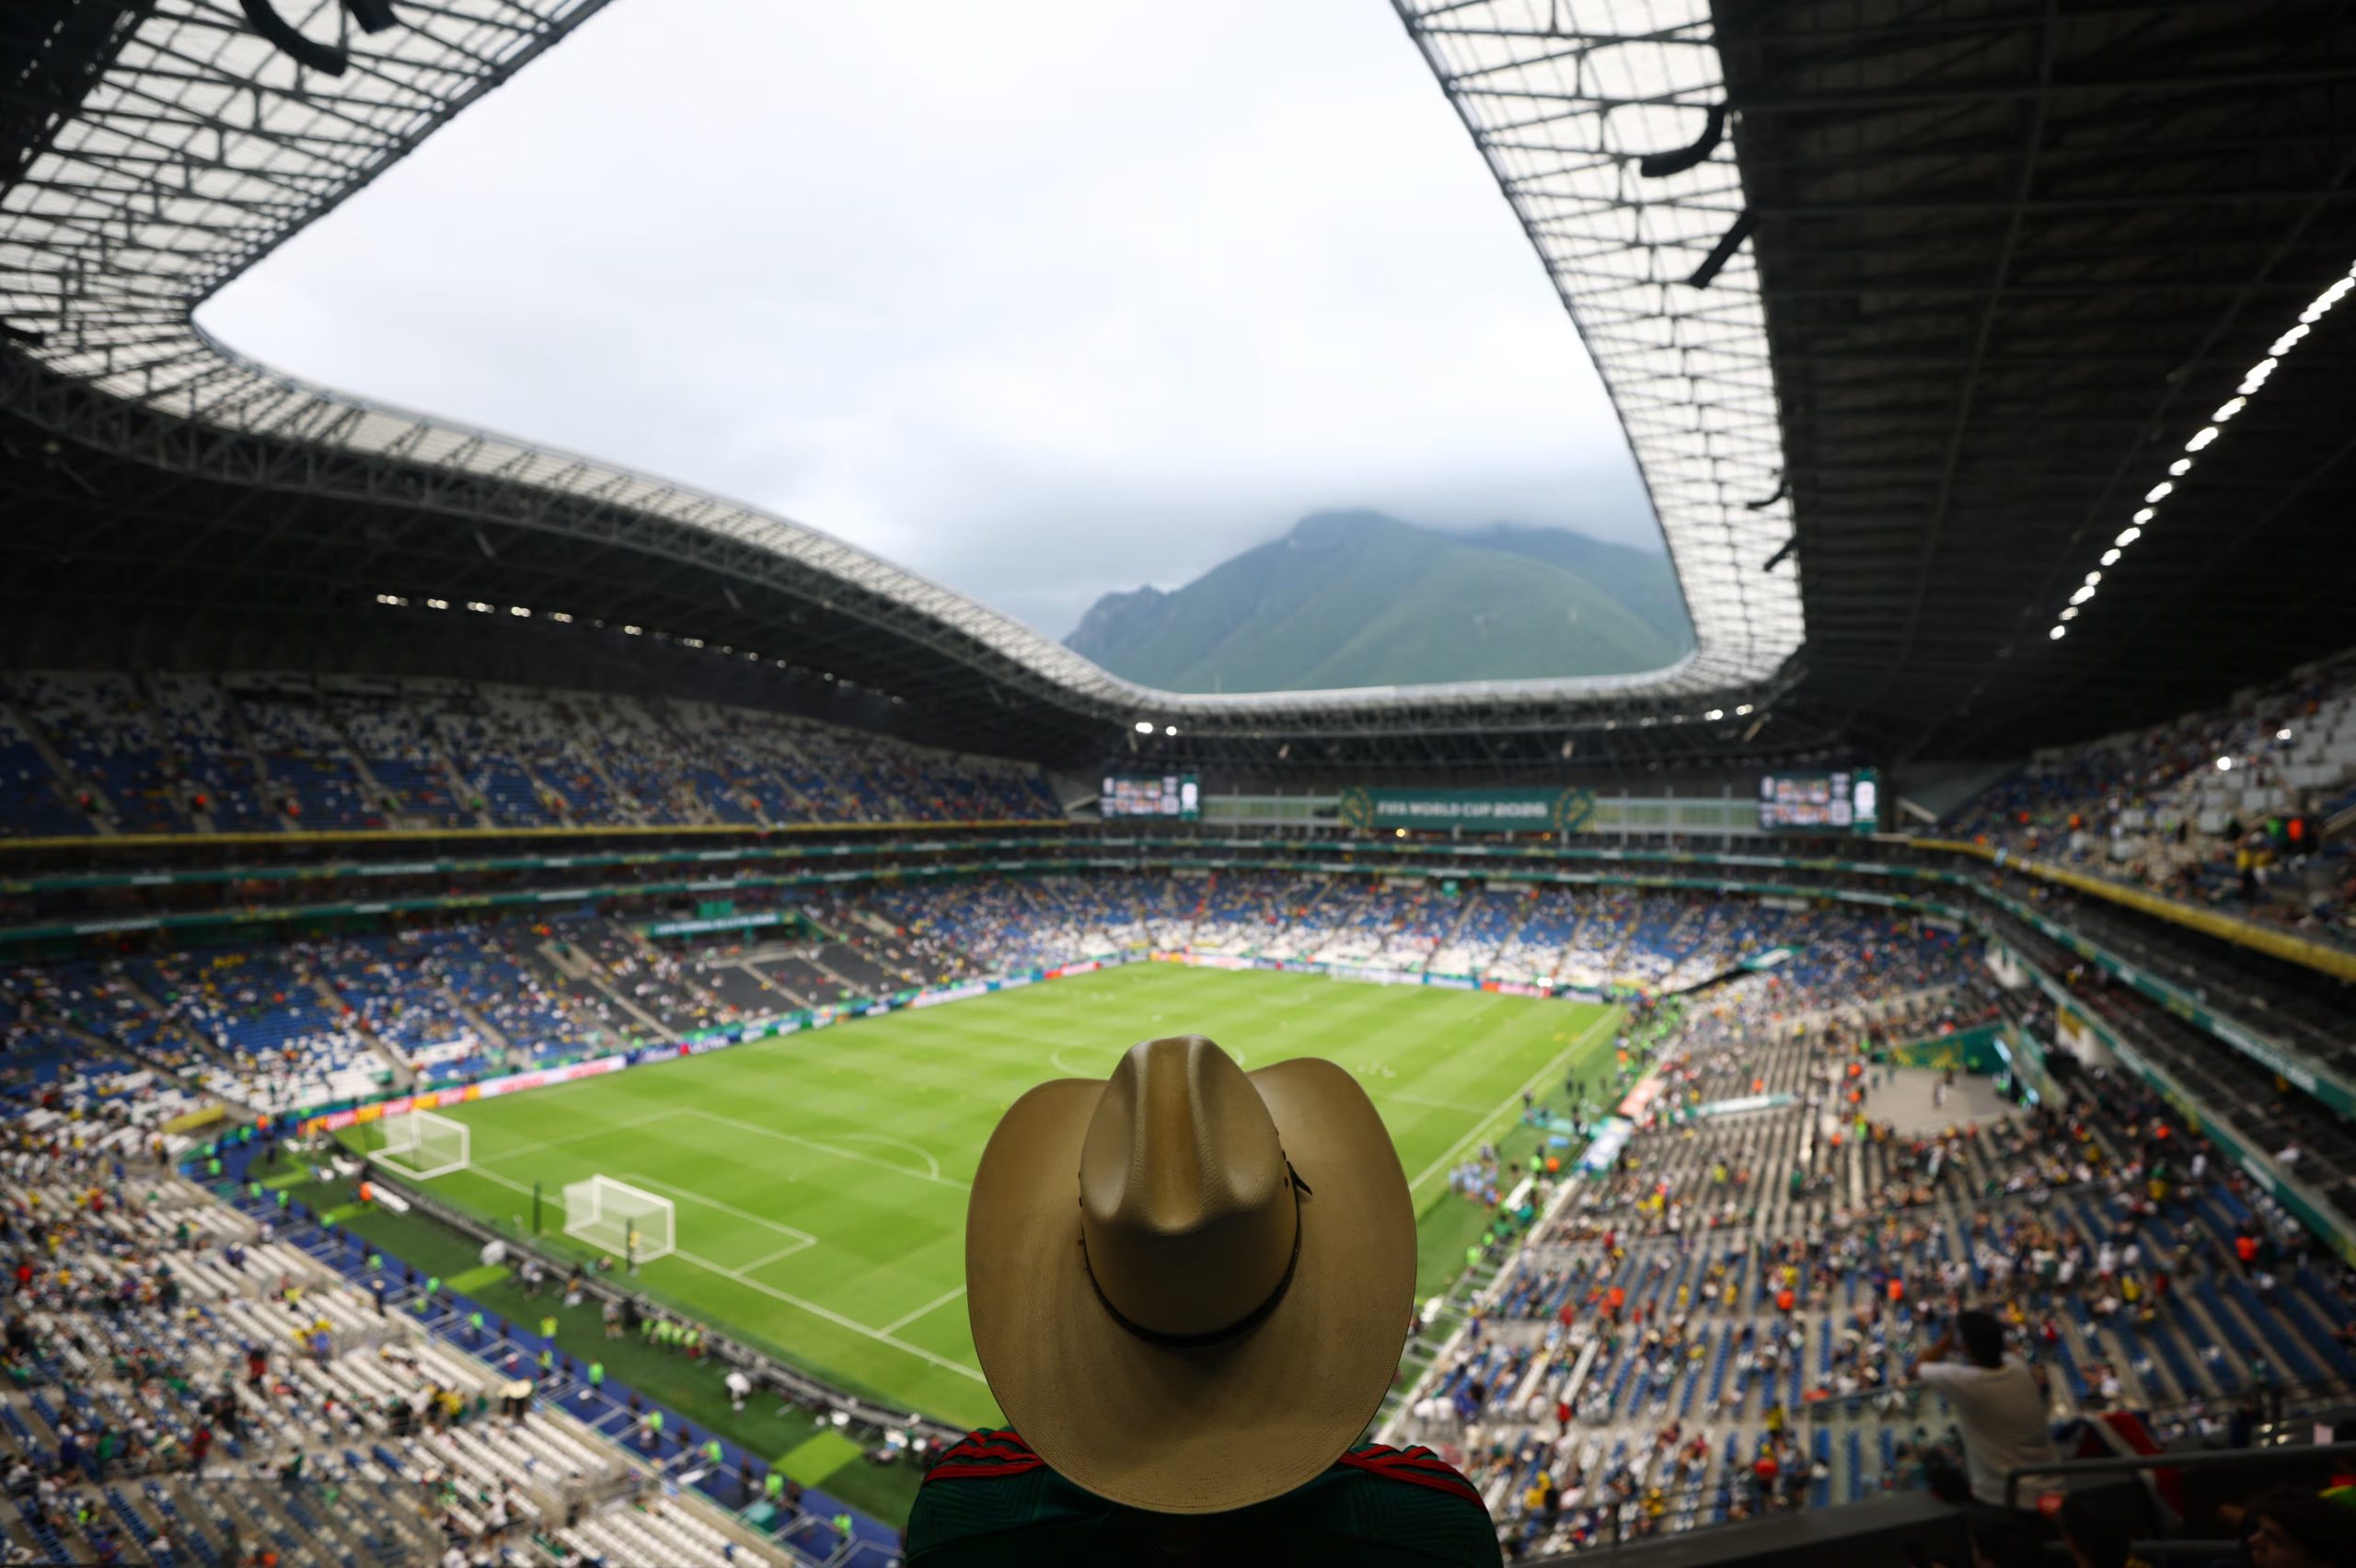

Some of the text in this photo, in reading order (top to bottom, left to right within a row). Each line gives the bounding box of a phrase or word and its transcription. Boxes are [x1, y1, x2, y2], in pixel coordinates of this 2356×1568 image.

[1377, 801, 1548, 818] FIFA WORLD CUP 2026
